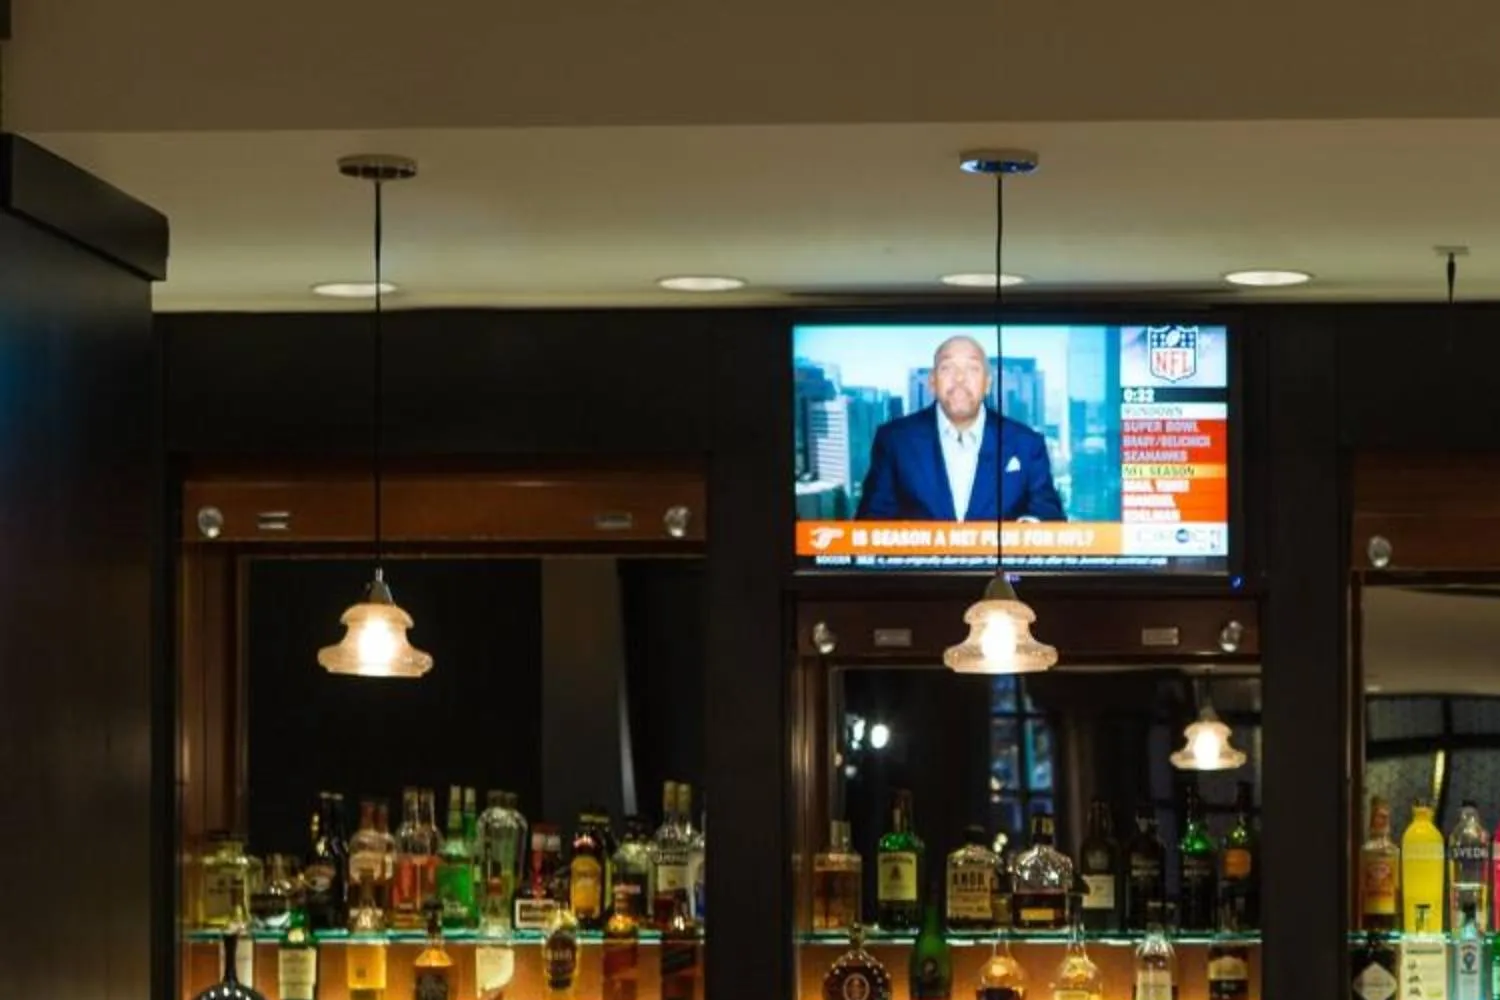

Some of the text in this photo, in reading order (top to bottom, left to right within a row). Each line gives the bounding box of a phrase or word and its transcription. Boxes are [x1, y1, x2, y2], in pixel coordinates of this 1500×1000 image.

[1155, 350, 1193, 377] NFL
[1149, 465, 1195, 476] SEASON
[871, 528, 932, 547] SEASON
[935, 528, 946, 547] A
[1023, 528, 1054, 547] FOR
